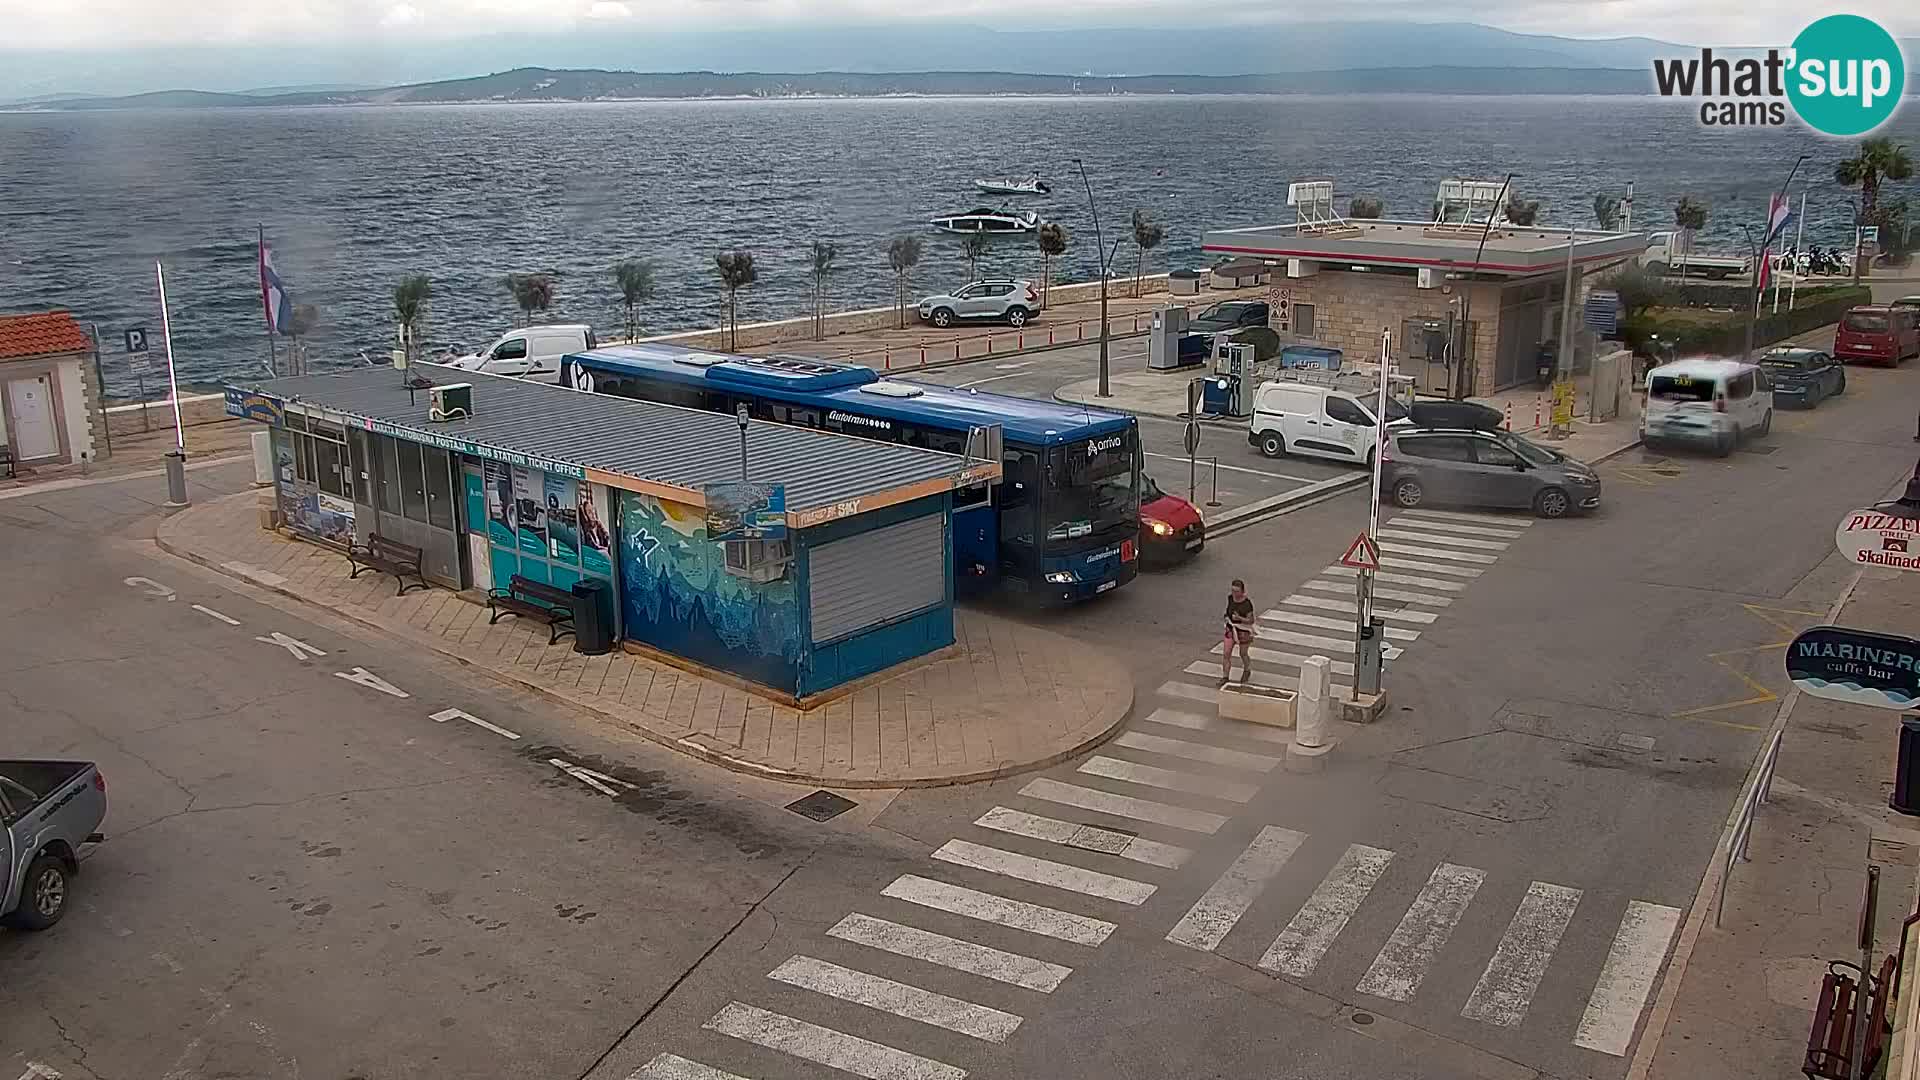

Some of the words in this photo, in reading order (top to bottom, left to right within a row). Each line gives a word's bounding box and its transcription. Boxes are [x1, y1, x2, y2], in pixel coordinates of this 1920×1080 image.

[130, 331, 142, 350] P
[1673, 378, 1693, 387] TAXI
[435, 436, 468, 453] POSTAJA
[477, 446, 493, 459] BUS
[493, 450, 527, 466] STATION
[527, 457, 554, 472] TICKET
[555, 463, 582, 477] OFFICE
[1879, 530, 1913, 540] GRILL
[1868, 665, 1895, 680] bar
